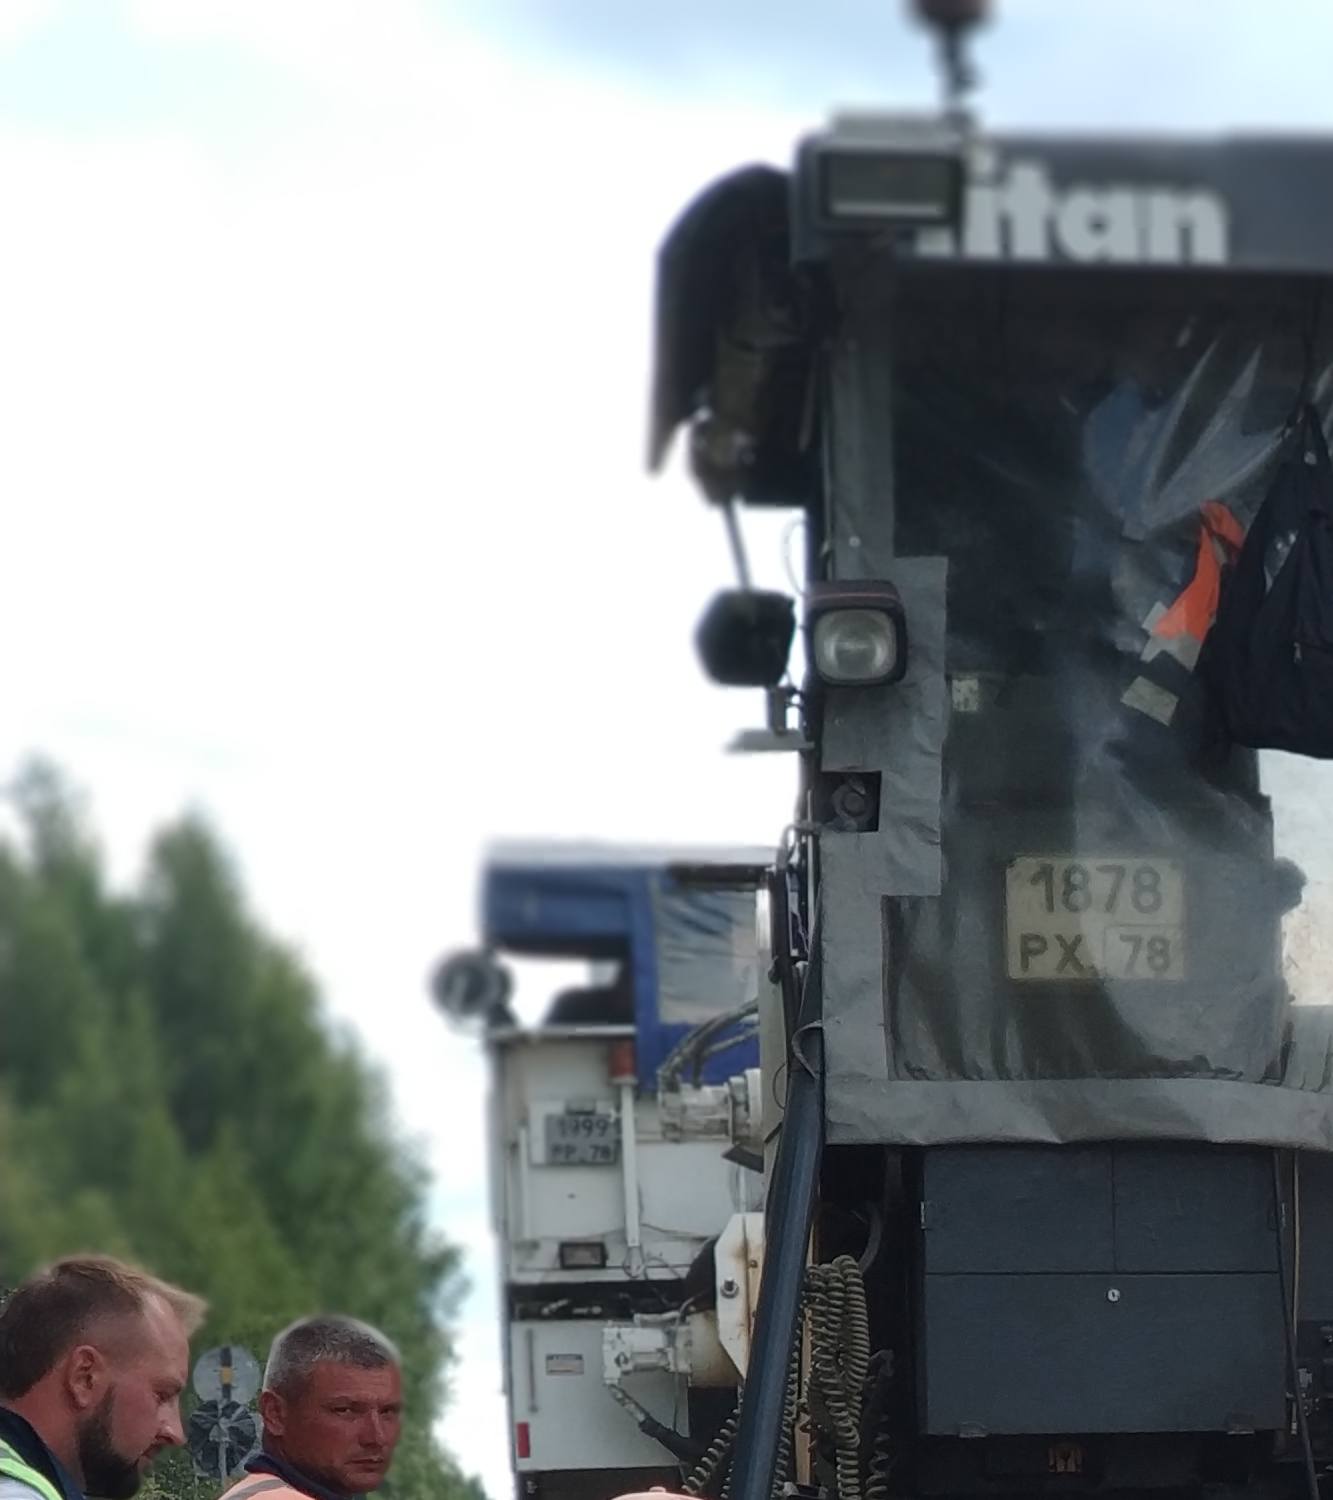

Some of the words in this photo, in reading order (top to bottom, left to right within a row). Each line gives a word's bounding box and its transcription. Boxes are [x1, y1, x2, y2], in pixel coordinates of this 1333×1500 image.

[915, 150, 1230, 263] itan
[1030, 863, 1163, 914] 1878
[1020, 932, 1085, 973] РХ
[1119, 933, 1171, 973] 78
